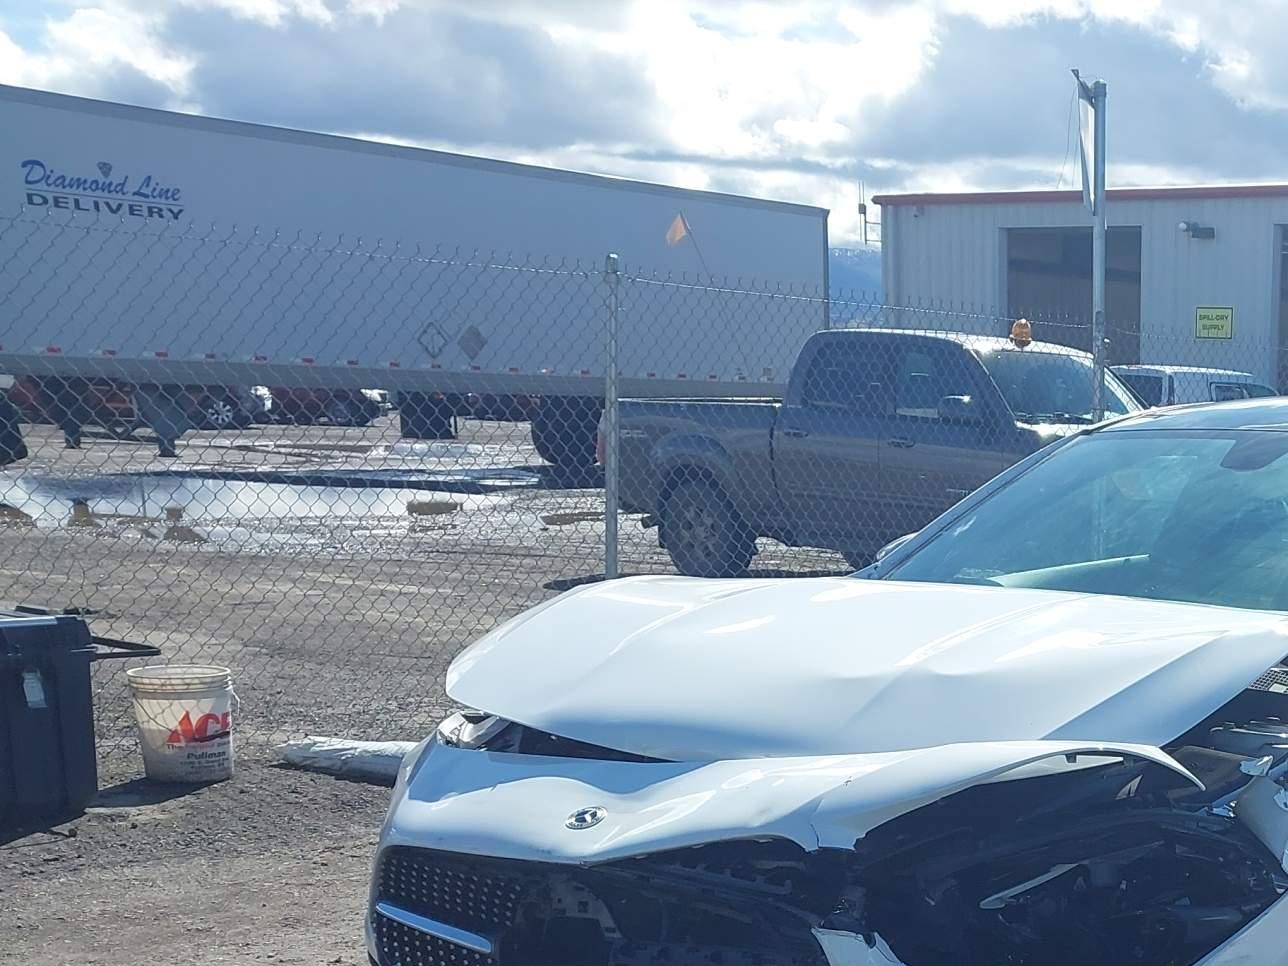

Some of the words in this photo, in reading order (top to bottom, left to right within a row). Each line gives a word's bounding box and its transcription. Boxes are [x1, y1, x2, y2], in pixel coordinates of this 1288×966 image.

[21, 159, 128, 196] Diamond
[131, 175, 181, 201] Line
[26, 192, 184, 220] DELIVERY
